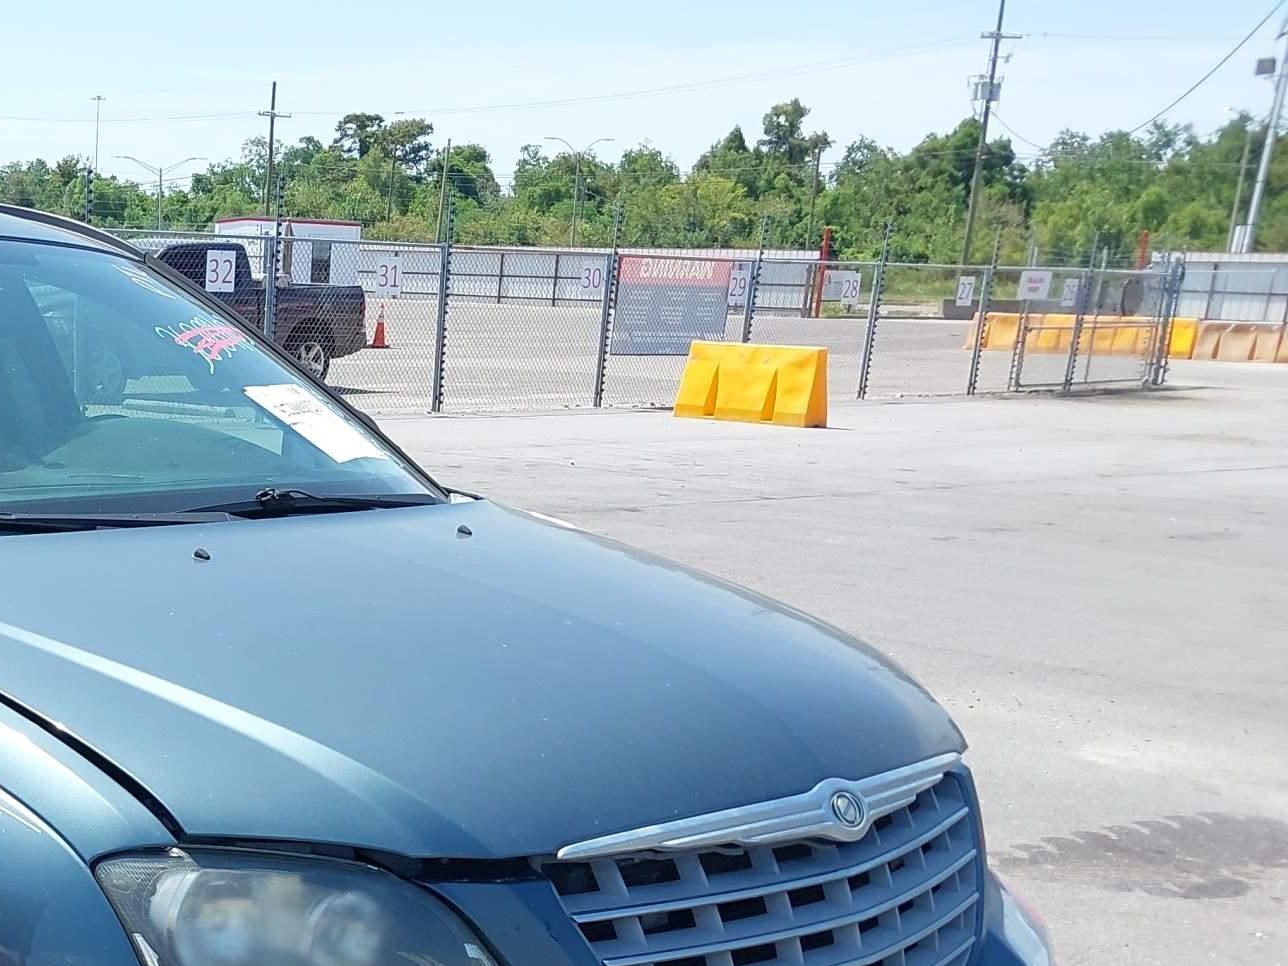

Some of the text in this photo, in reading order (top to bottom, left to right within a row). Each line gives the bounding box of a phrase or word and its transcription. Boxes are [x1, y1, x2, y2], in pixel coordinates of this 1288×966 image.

[208, 257, 234, 285] 32
[379, 263, 399, 289] 31
[581, 267, 602, 290] 30
[729, 276, 747, 298] 29
[842, 279, 859, 299] 28
[958, 281, 973, 301] 27
